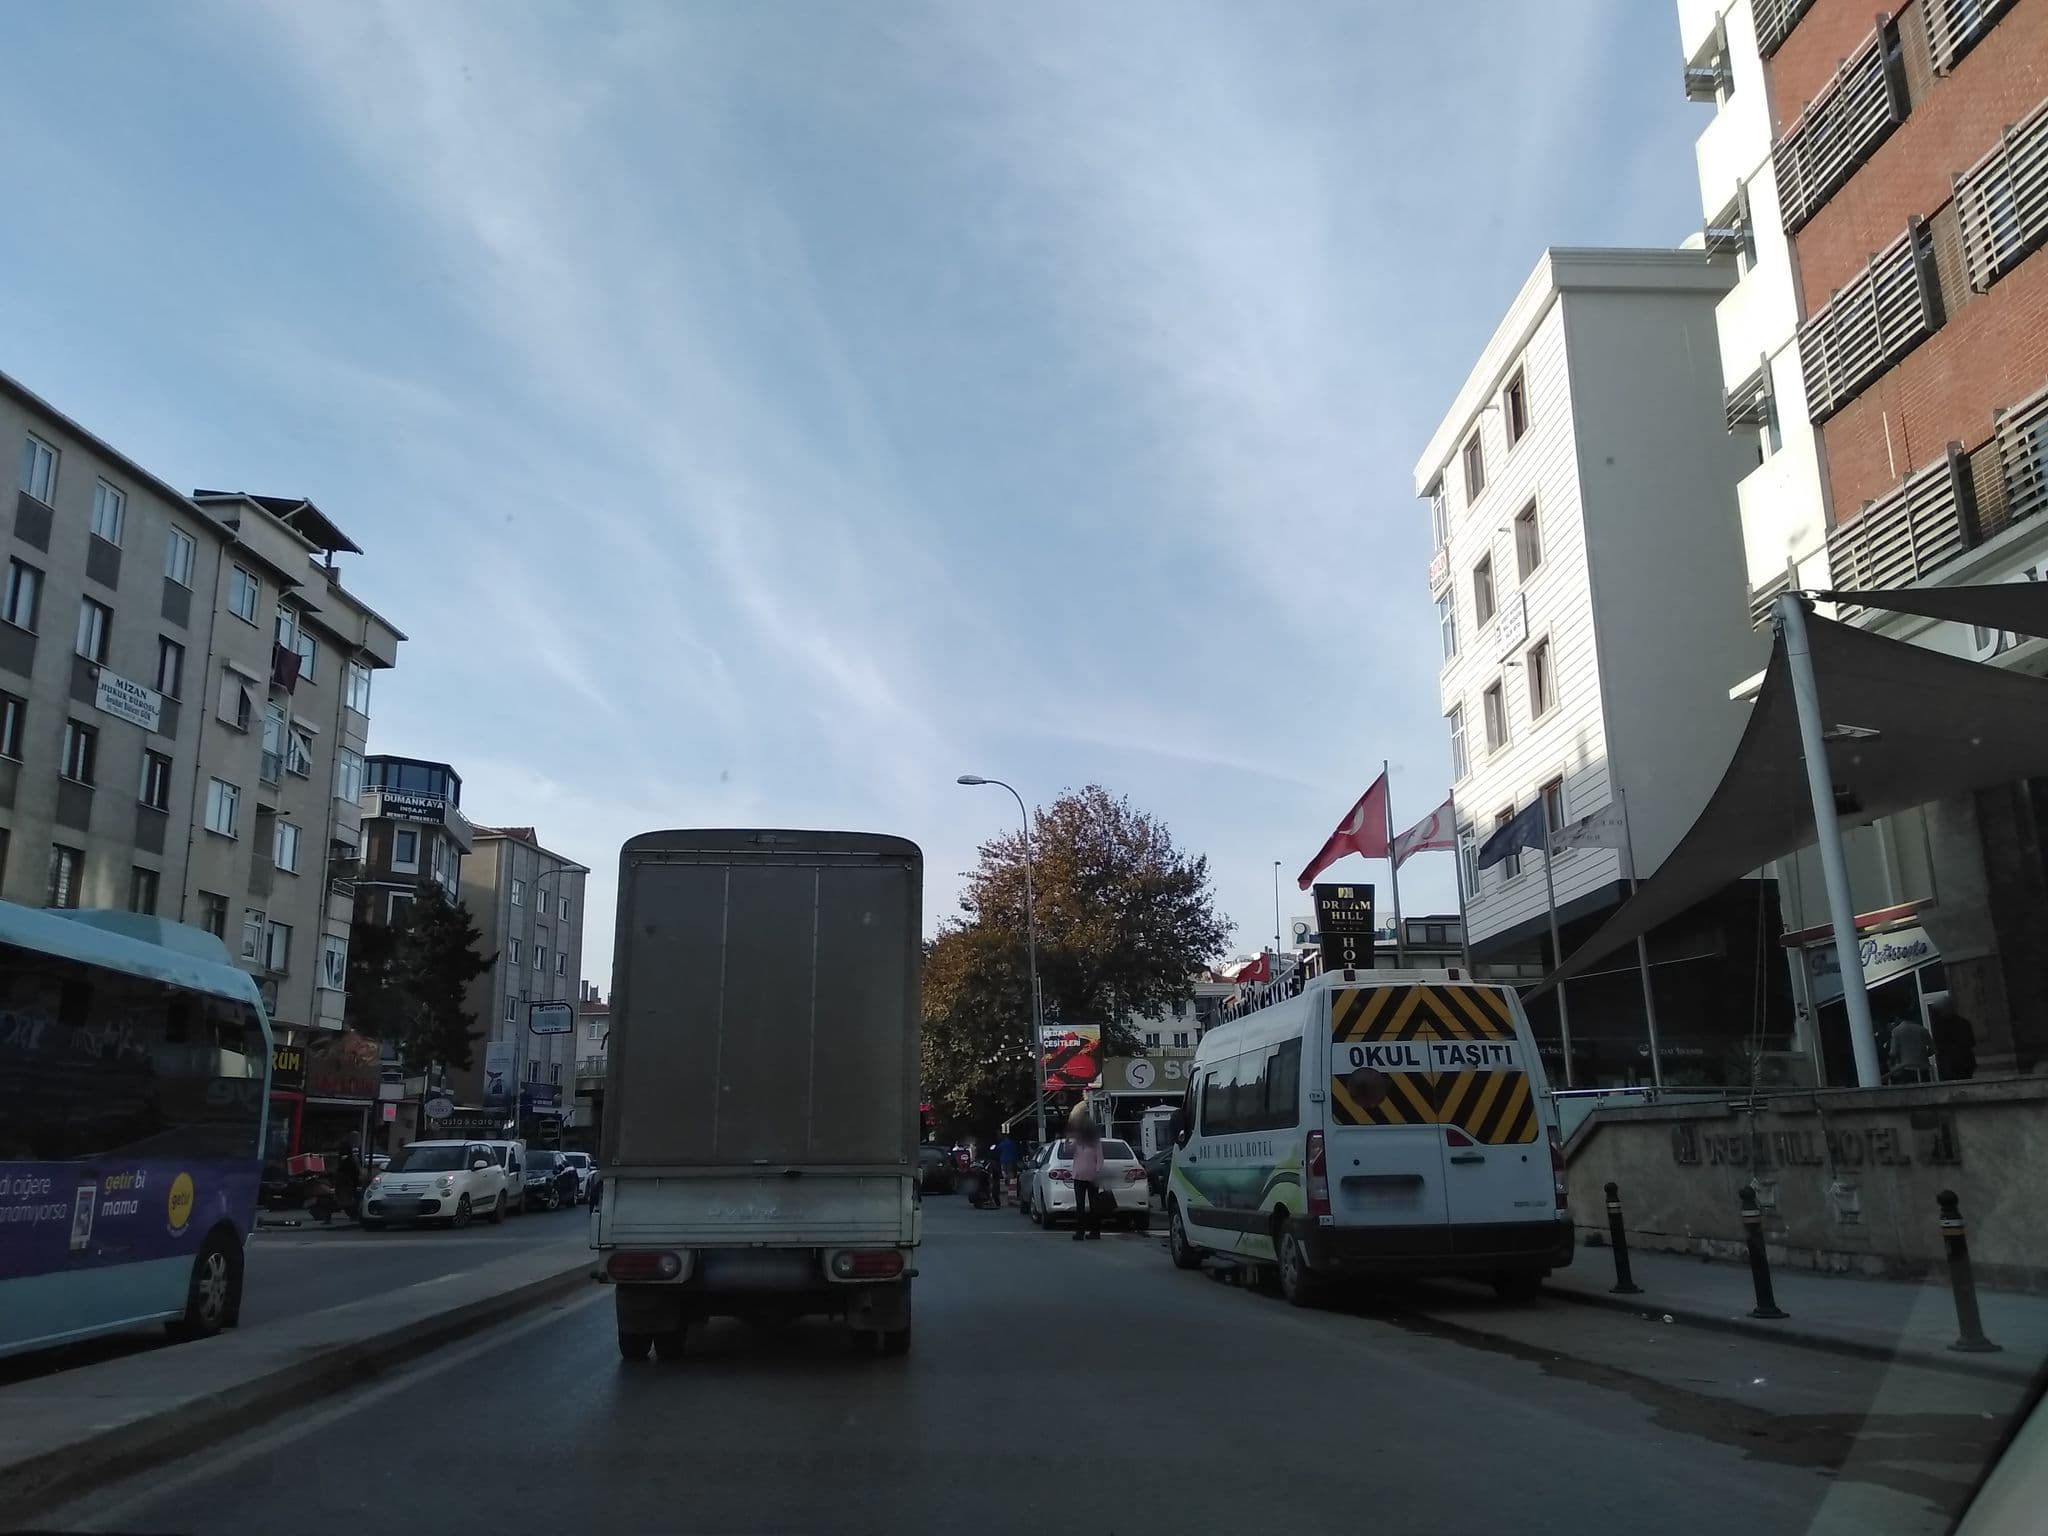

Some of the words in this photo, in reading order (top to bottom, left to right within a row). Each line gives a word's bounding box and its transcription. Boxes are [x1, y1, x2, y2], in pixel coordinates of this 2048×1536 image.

[384, 794, 443, 809] DUMANKAYA
[1322, 900, 1371, 910] DRAM
[1332, 911, 1364, 920] HILL
[1349, 1045, 1421, 1067] OKUL
[1433, 1044, 1513, 1069] TAŞITI
[105, 1171, 134, 1195] getir
[135, 1169, 146, 1189] bi
[101, 1200, 138, 1217] mama
